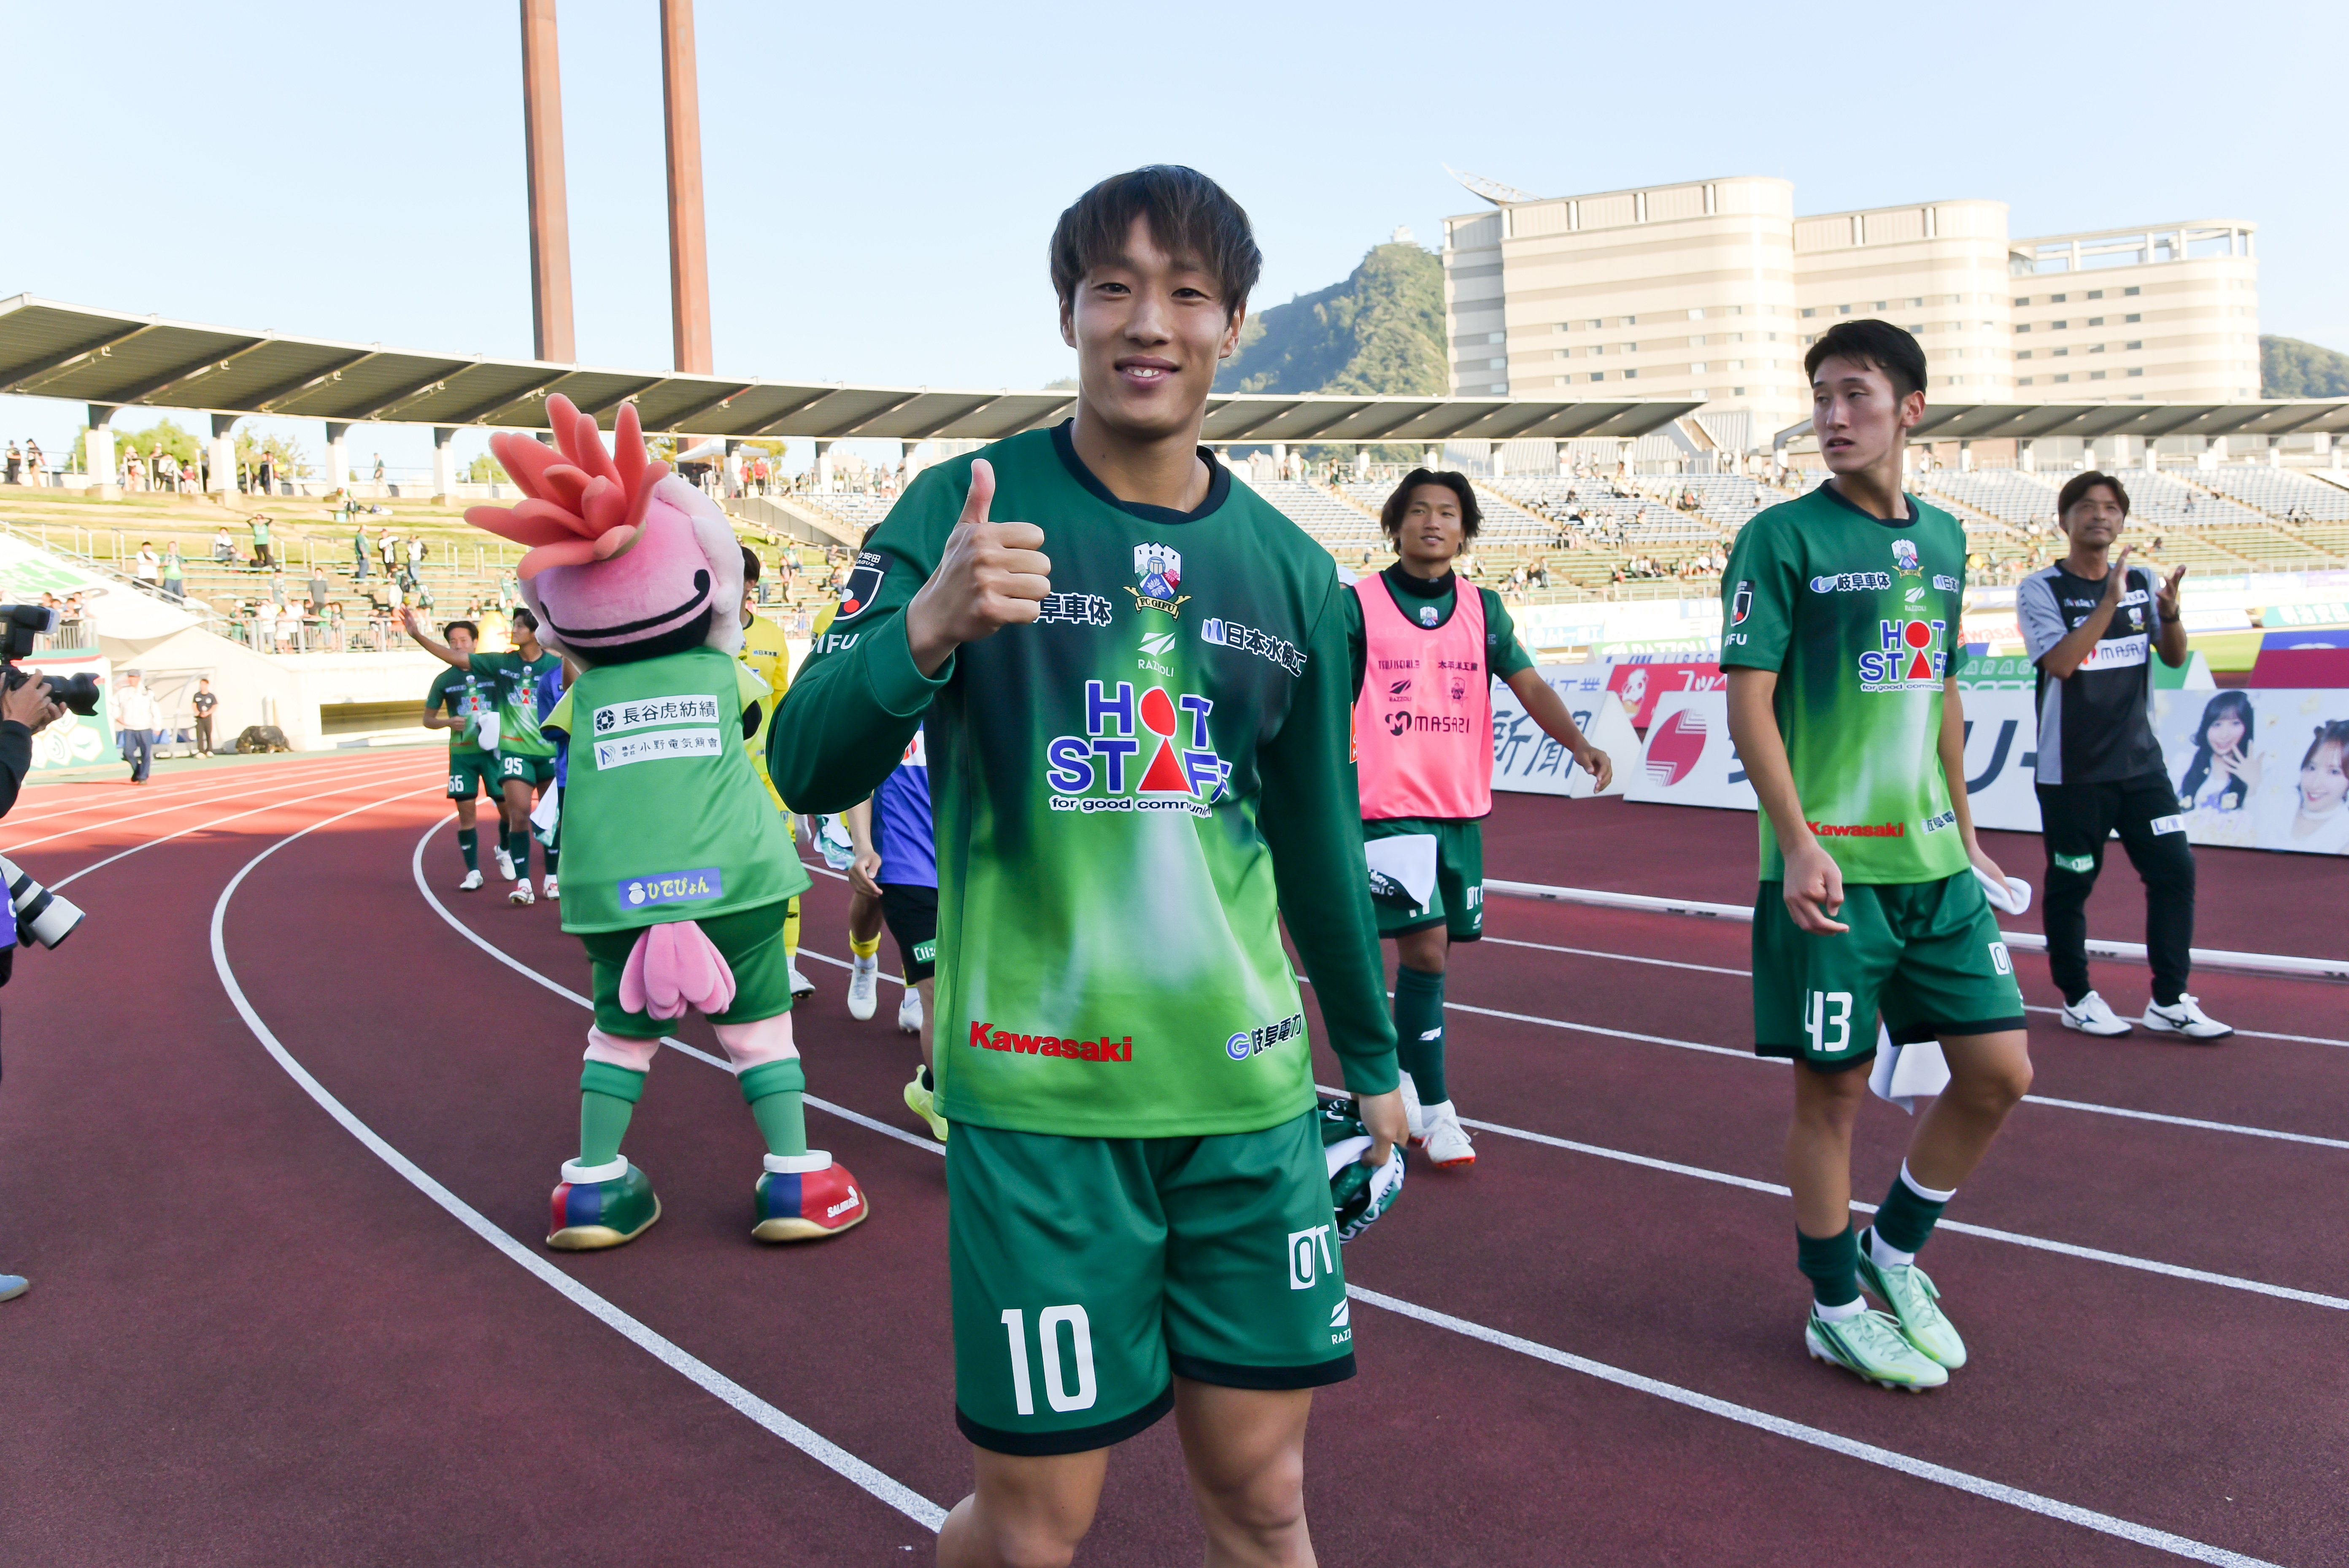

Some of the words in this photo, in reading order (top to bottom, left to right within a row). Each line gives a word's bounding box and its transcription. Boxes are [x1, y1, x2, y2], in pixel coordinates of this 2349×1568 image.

[1140, 598, 1150, 606] FC
[1151, 599, 1176, 613] GIFU
[1880, 619, 1946, 650] HOT
[1138, 659, 1174, 677] RAZZOLI
[623, 700, 717, 725] 長谷虎紡績
[1086, 681, 1213, 750] HOT
[504, 757, 523, 775] 95
[1047, 737, 1232, 803] STAFF
[1051, 798, 1077, 808] for
[1083, 799, 1131, 810] good
[1806, 821, 1904, 837] Kawasaki
[647, 876, 710, 899] ひでぴょん
[1804, 988, 1853, 1052] 43
[970, 1021, 1132, 1062] Kawasaki
[1001, 1304, 1097, 1415] 10
